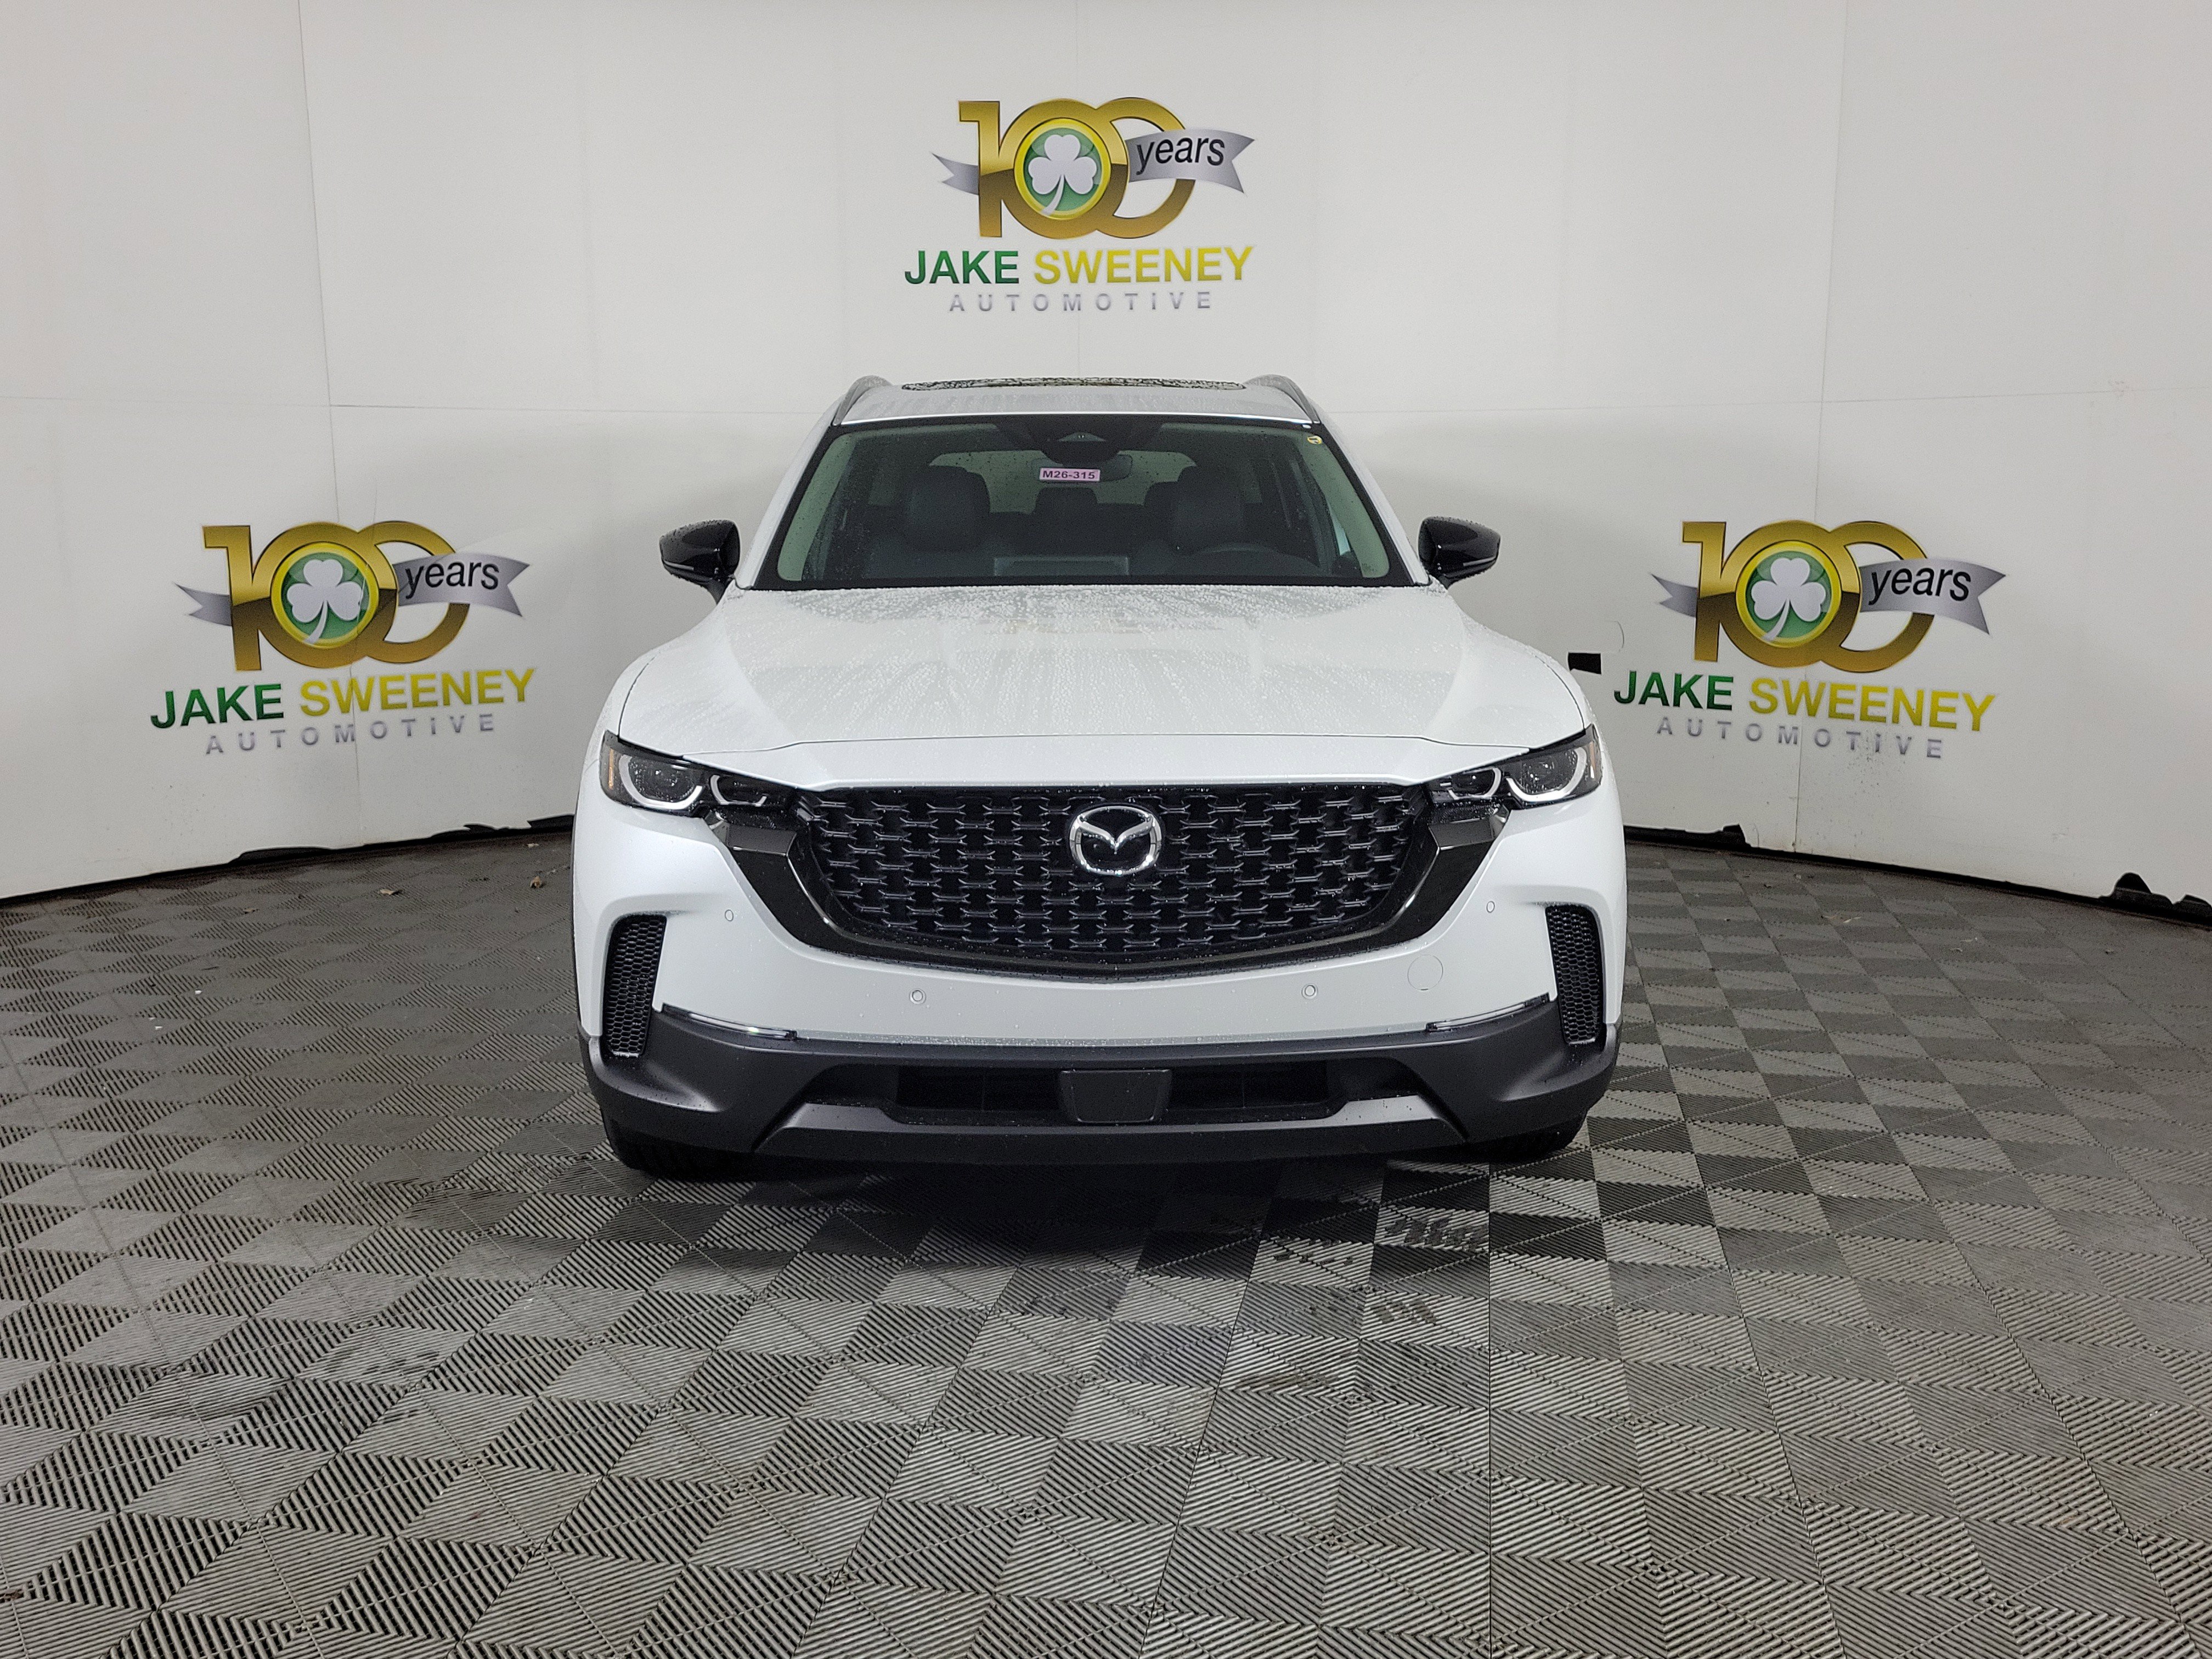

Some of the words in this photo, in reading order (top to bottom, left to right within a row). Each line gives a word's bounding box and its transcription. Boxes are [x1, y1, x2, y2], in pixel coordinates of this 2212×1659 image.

[958, 97, 1196, 240] 100
[1136, 136, 1225, 175] years
[904, 250, 1019, 284] JAKE
[1034, 246, 1254, 284] SWEENEY
[949, 291, 1211, 312] AUTOMOTIVE
[1042, 470, 1096, 479] M26-315
[202, 521, 470, 671] 100
[404, 560, 500, 599] years
[1681, 520, 1935, 673] 100
[1868, 567, 1972, 605] years
[150, 683, 284, 729] JAKE
[300, 668, 535, 716] SWEENEY
[1613, 670, 1734, 711] JAKE
[1748, 677, 1996, 732] SWEENEY
[205, 713, 494, 755] AUTOMOTIVE
[1656, 716, 1943, 759] AUTOMOTIVE
